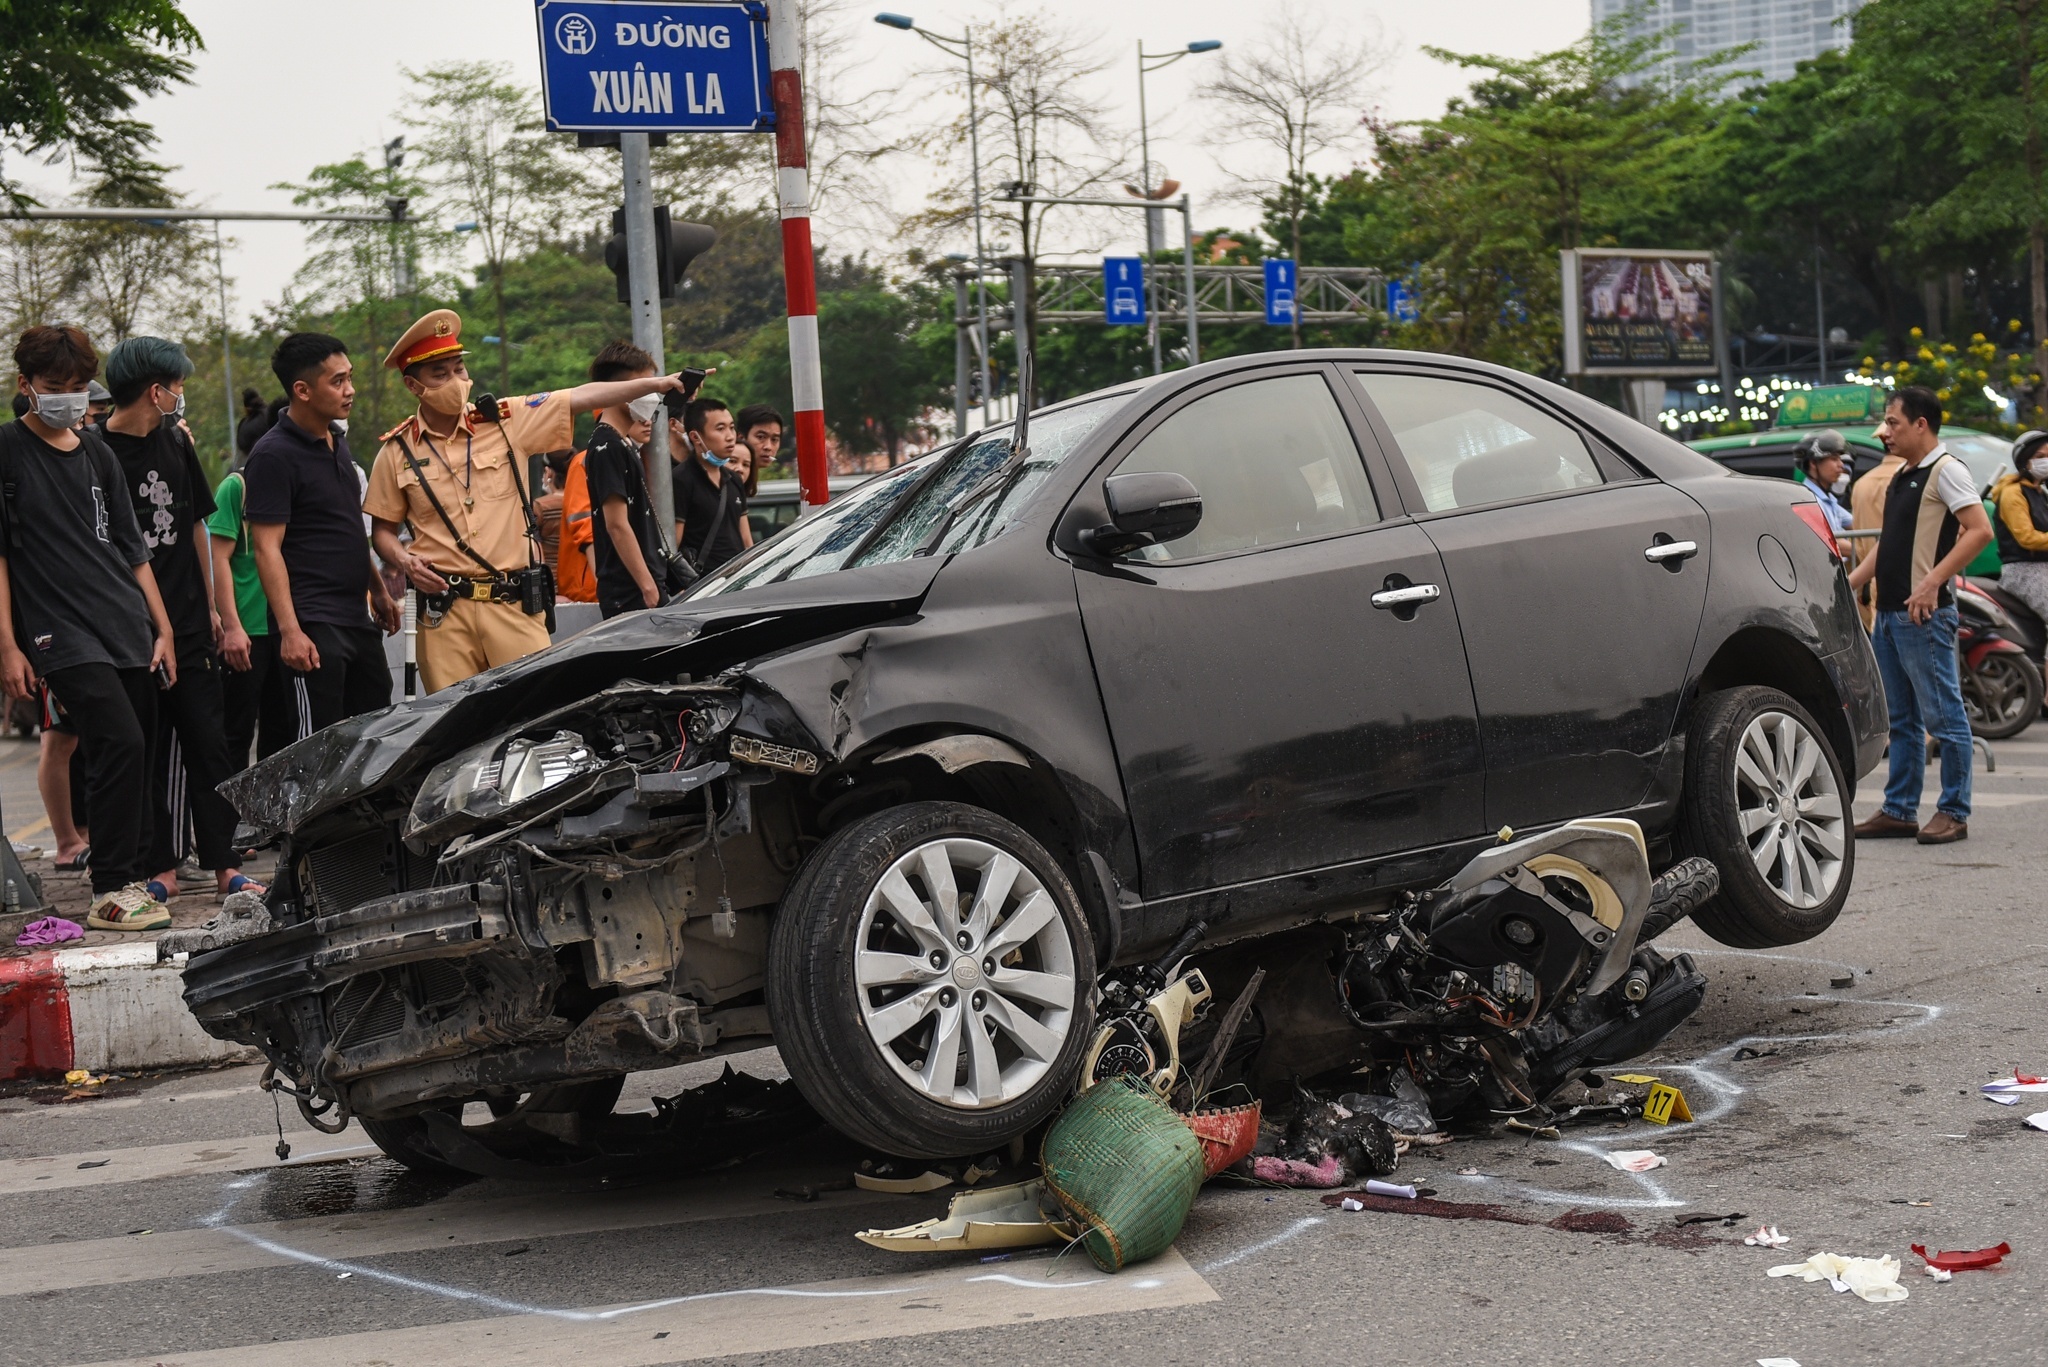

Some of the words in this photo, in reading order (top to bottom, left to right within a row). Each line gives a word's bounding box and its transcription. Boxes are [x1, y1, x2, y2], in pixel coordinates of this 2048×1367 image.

[614, 15, 731, 49] ĐƯỜNG
[589, 62, 673, 114] XUÂN
[685, 72, 726, 114] LA
[1748, 694, 1801, 712] BRIDGESTONE
[865, 812, 962, 869] DGESTONE
[1652, 1090, 1672, 1116] 17
